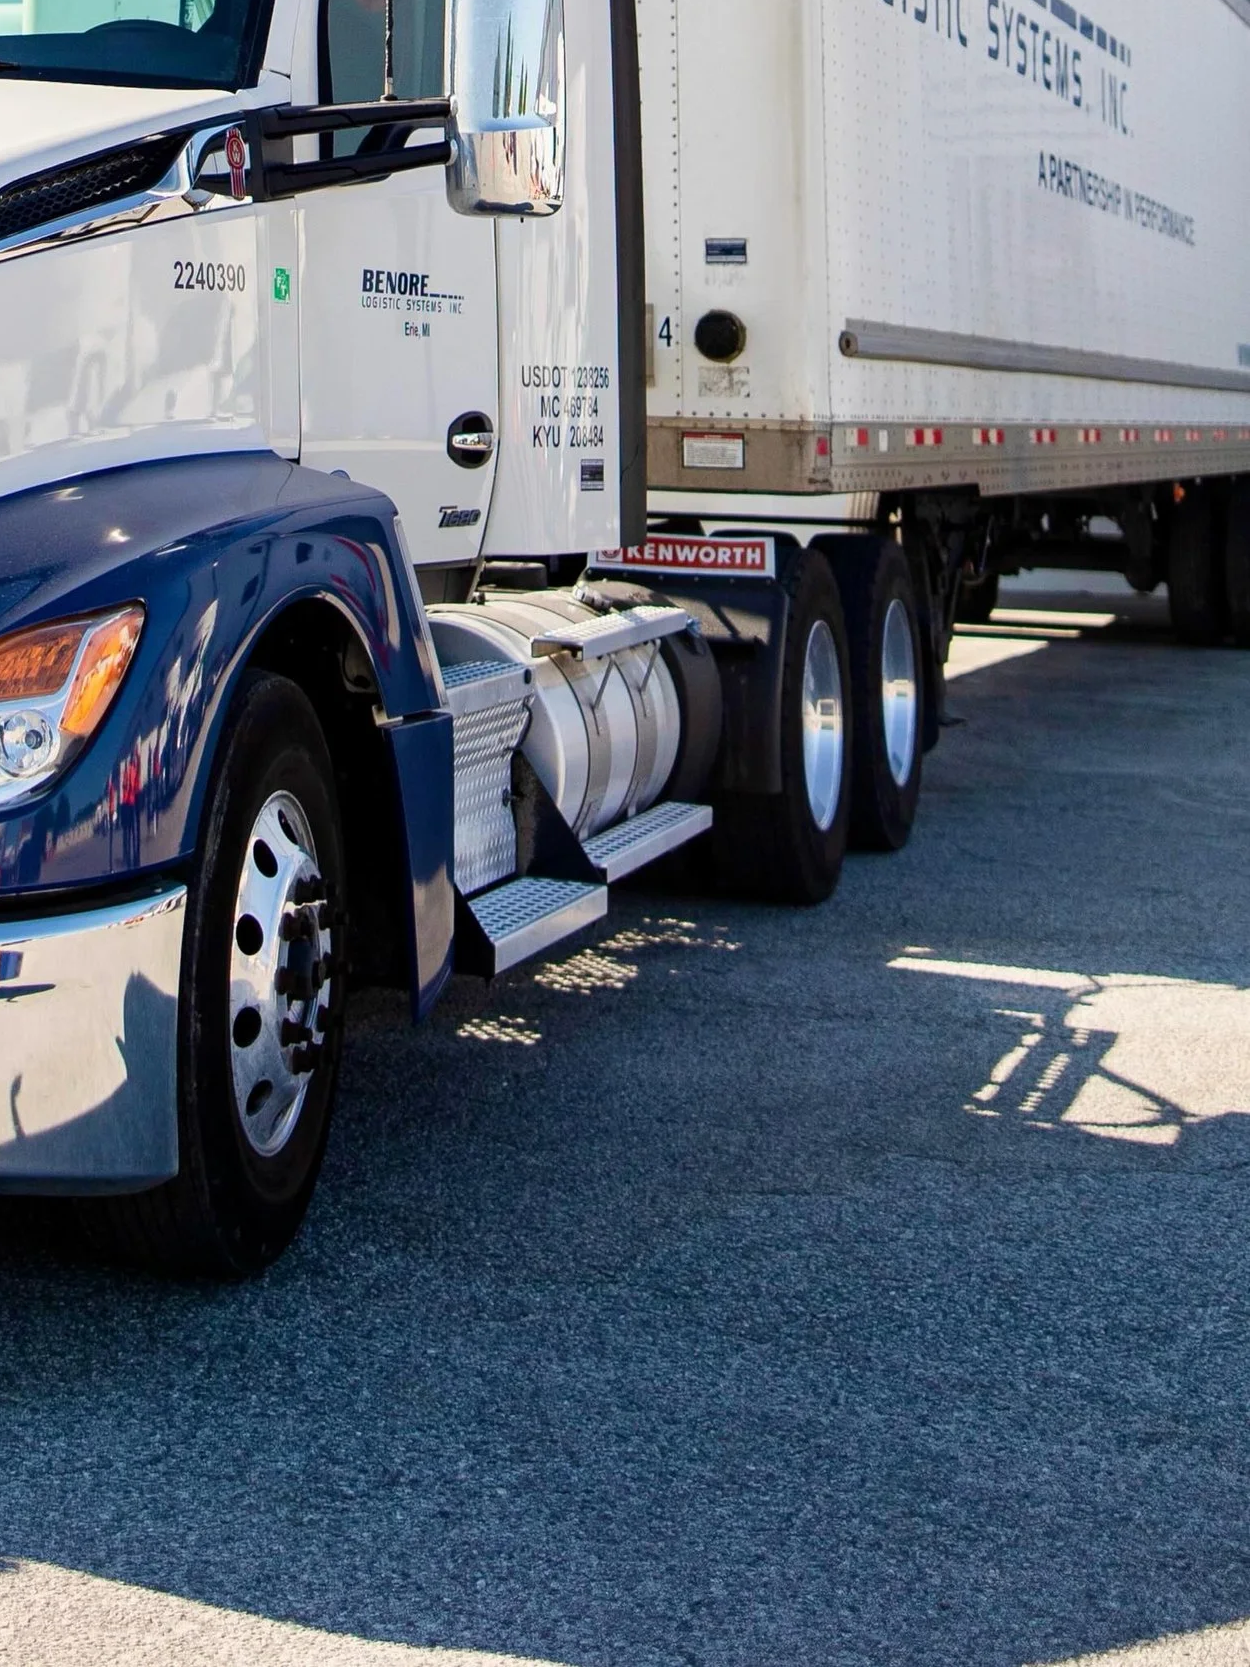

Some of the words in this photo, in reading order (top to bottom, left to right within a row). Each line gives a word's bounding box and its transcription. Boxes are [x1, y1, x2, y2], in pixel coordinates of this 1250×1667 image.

[1038, 150, 1048, 190] A
[1049, 153, 1121, 217] PARTNERSHIP
[173, 261, 246, 292] 2240390
[361, 269, 430, 297] BENORE
[361, 295, 401, 310] LOGISTIC
[406, 299, 443, 314] SYSTEMS
[449, 302, 464, 315] INC
[404, 322, 421, 339] Erie,
[422, 322, 431, 337] MI
[658, 316, 673, 348] 4
[521, 365, 568, 389] USDOT
[540, 395, 561, 418] MC
[533, 425, 561, 449] KYU
[570, 425, 604, 448] 208484
[626, 542, 762, 566] KENWORTH
